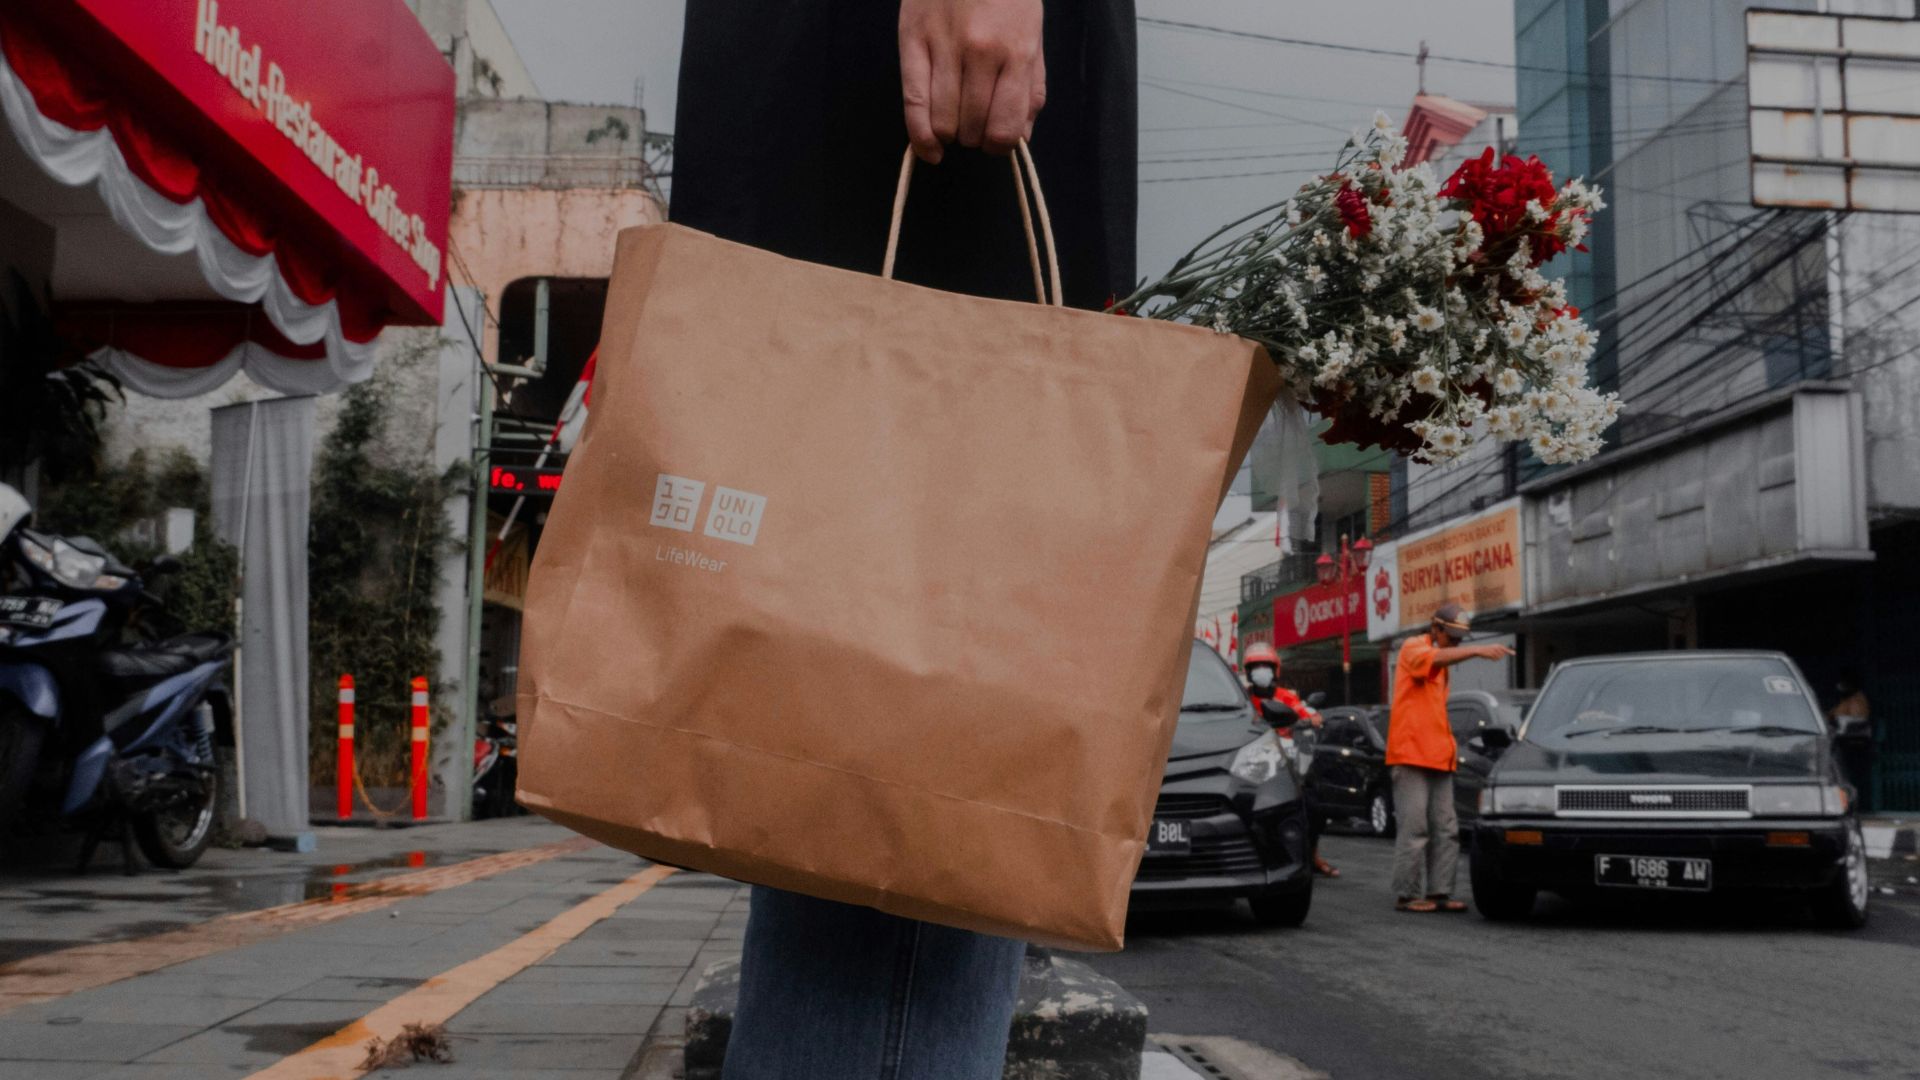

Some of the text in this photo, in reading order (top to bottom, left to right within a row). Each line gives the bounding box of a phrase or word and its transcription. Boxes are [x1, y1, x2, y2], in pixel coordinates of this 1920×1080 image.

[409, 213, 441, 292] Shop
[719, 493, 756, 517] UNI
[712, 514, 753, 537] QLO
[655, 545, 729, 573] LifeWear
[1402, 562, 1442, 595] SURYA
[1444, 542, 1514, 583] KENCANA
[1599, 856, 1707, 880] F 1686 AW
